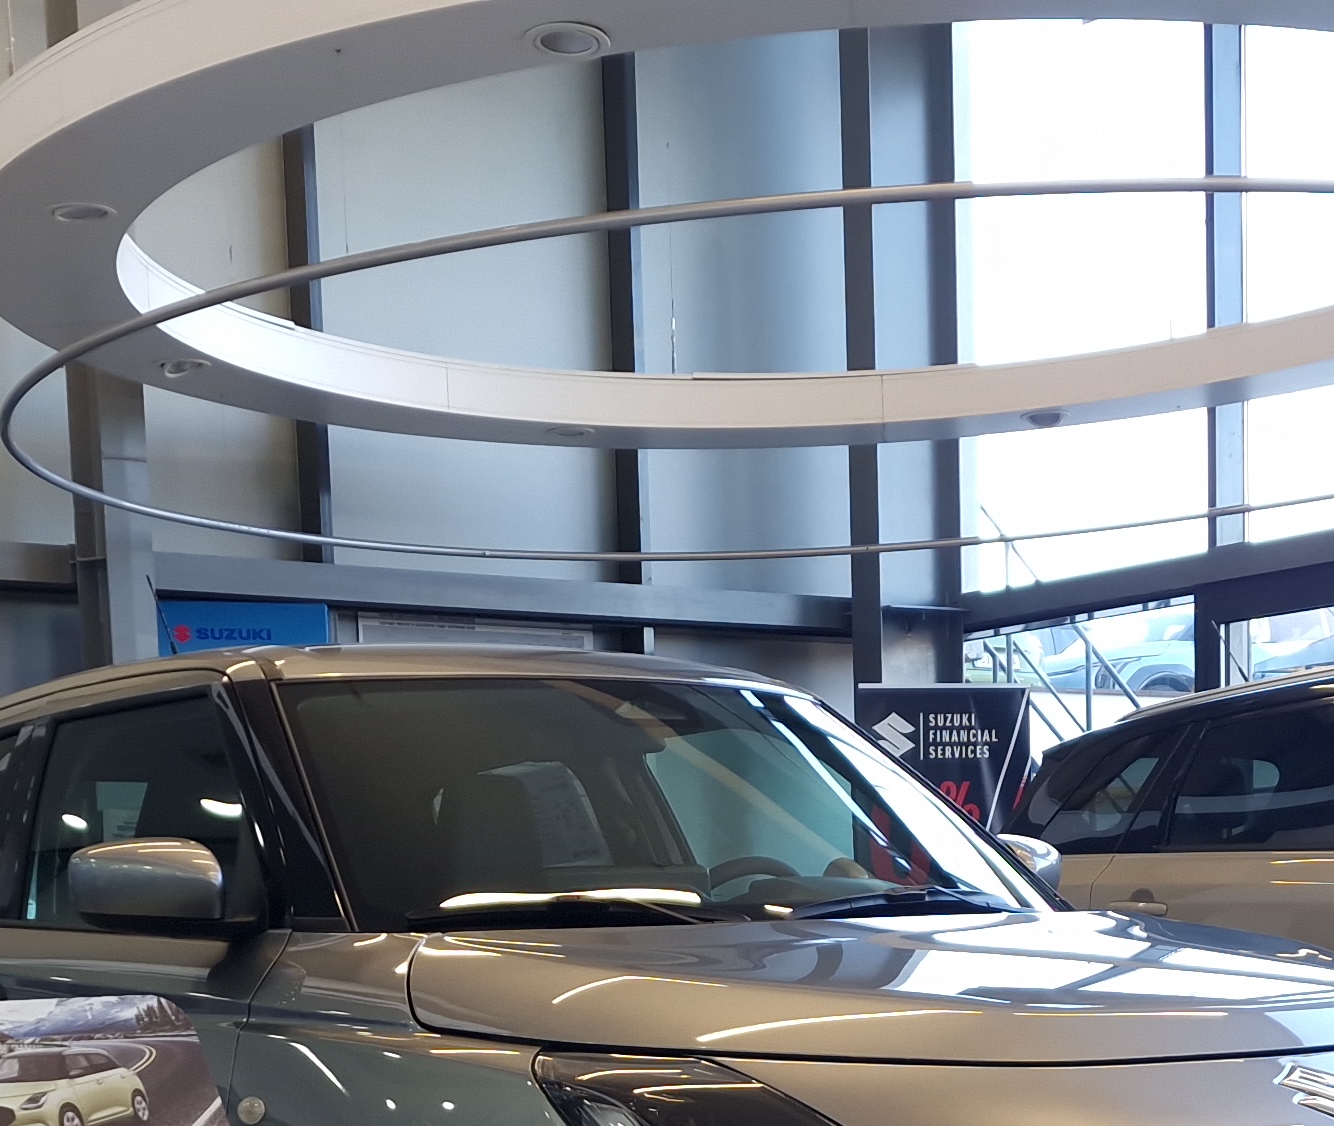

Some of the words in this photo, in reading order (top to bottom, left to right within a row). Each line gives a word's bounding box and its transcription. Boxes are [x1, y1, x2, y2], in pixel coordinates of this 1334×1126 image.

[195, 626, 272, 641] SUZUKI
[928, 713, 976, 727] SUZUKI
[928, 729, 999, 743] FINANCIAL
[928, 745, 990, 759] SERVICES
